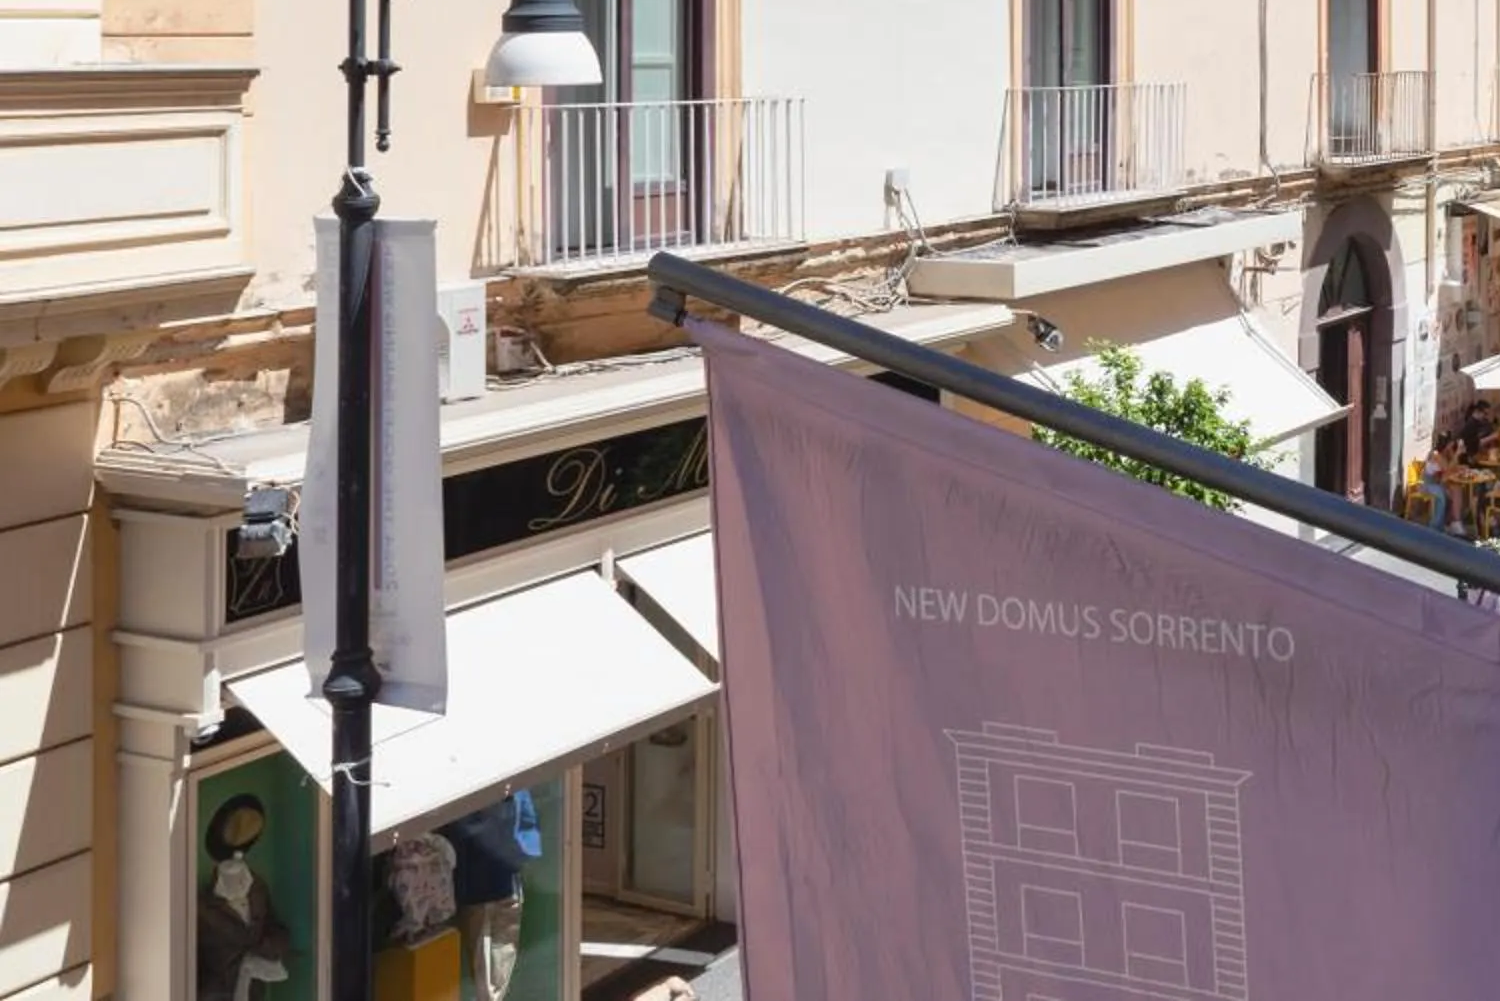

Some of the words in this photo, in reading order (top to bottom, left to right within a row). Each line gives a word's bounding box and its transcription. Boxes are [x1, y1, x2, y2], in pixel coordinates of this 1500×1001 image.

[528, 448, 624, 530] Di
[894, 585, 967, 623] NEW
[977, 592, 1101, 640] DOMUS
[1110, 607, 1295, 662] SORRENTO
